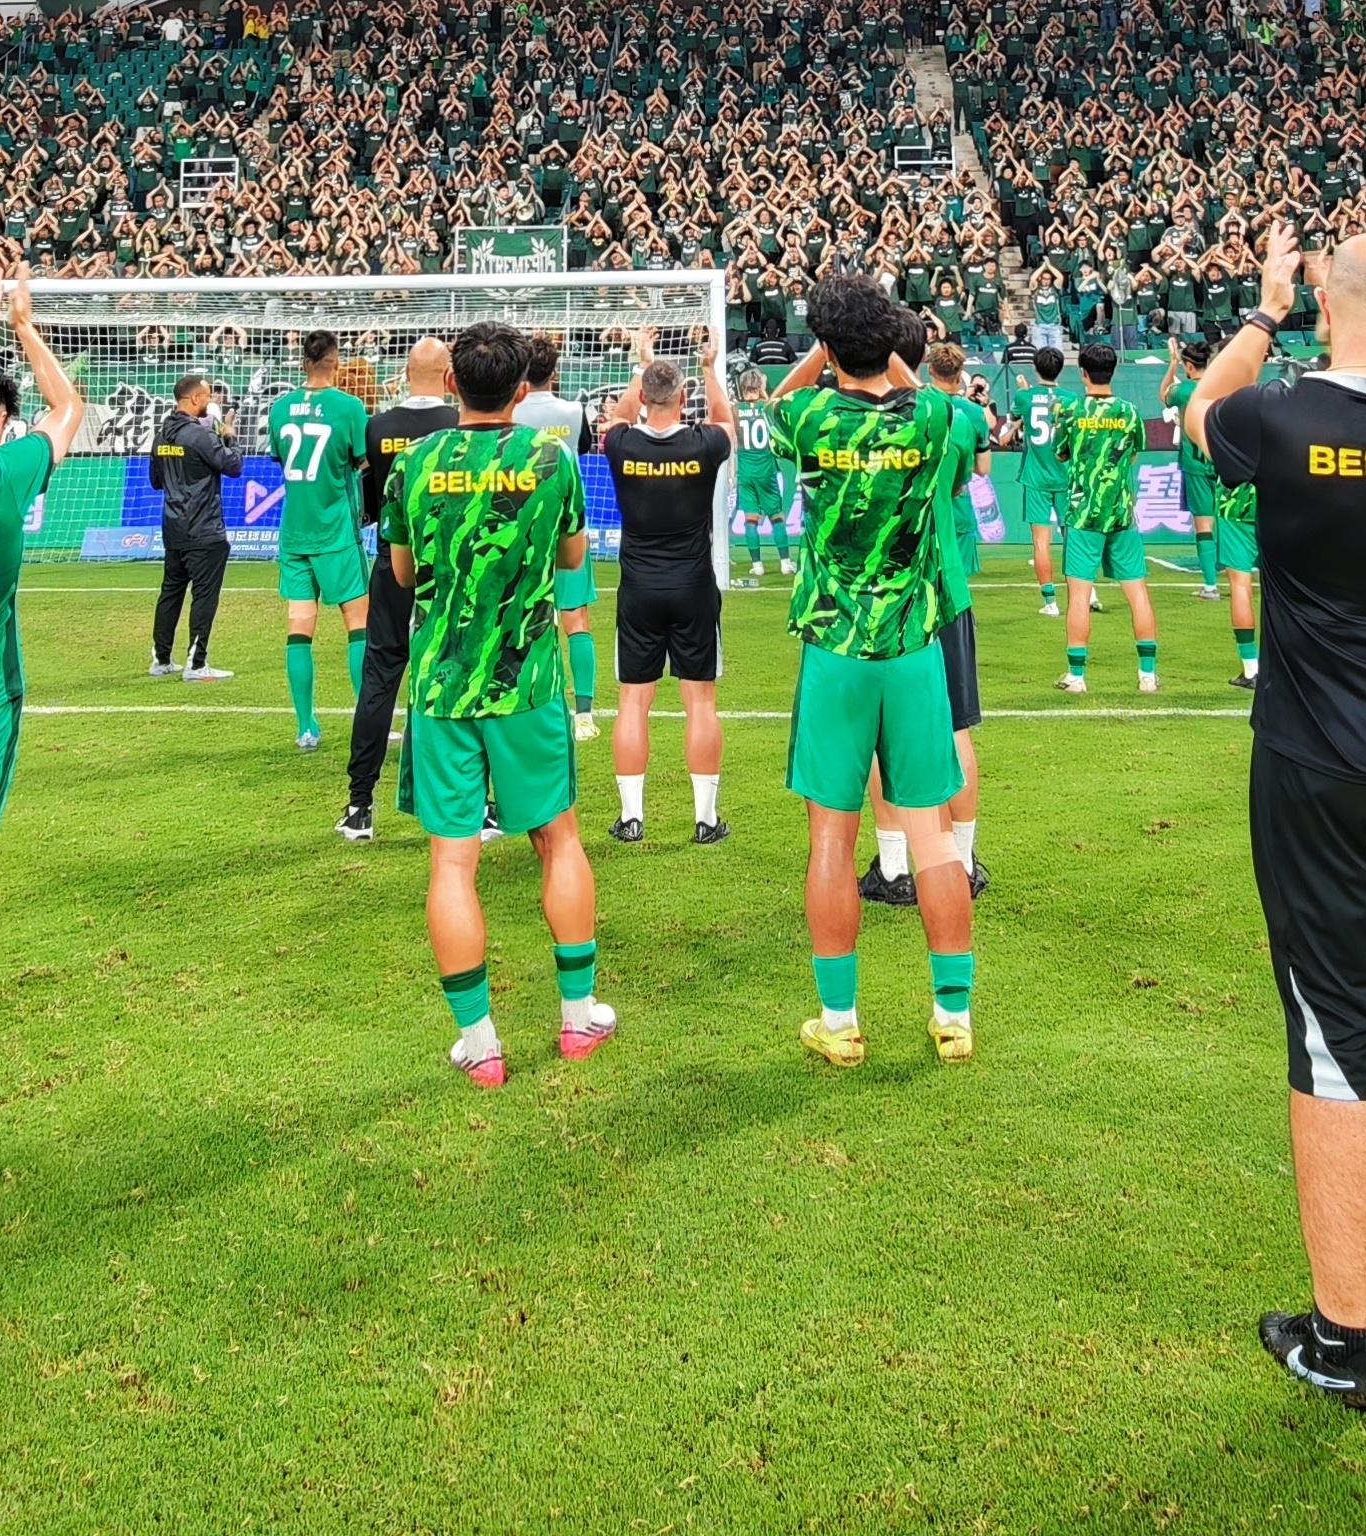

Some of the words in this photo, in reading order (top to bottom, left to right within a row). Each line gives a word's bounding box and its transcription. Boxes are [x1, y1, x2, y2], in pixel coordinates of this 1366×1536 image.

[739, 418, 768, 450] 10
[1078, 417, 1127, 431] BEIJING
[157, 444, 185, 457] BEIJING
[280, 423, 332, 482] 27
[818, 447, 921, 471] BEIJING
[622, 459, 701, 477] BEIJING
[428, 469, 537, 494] BEIJING
